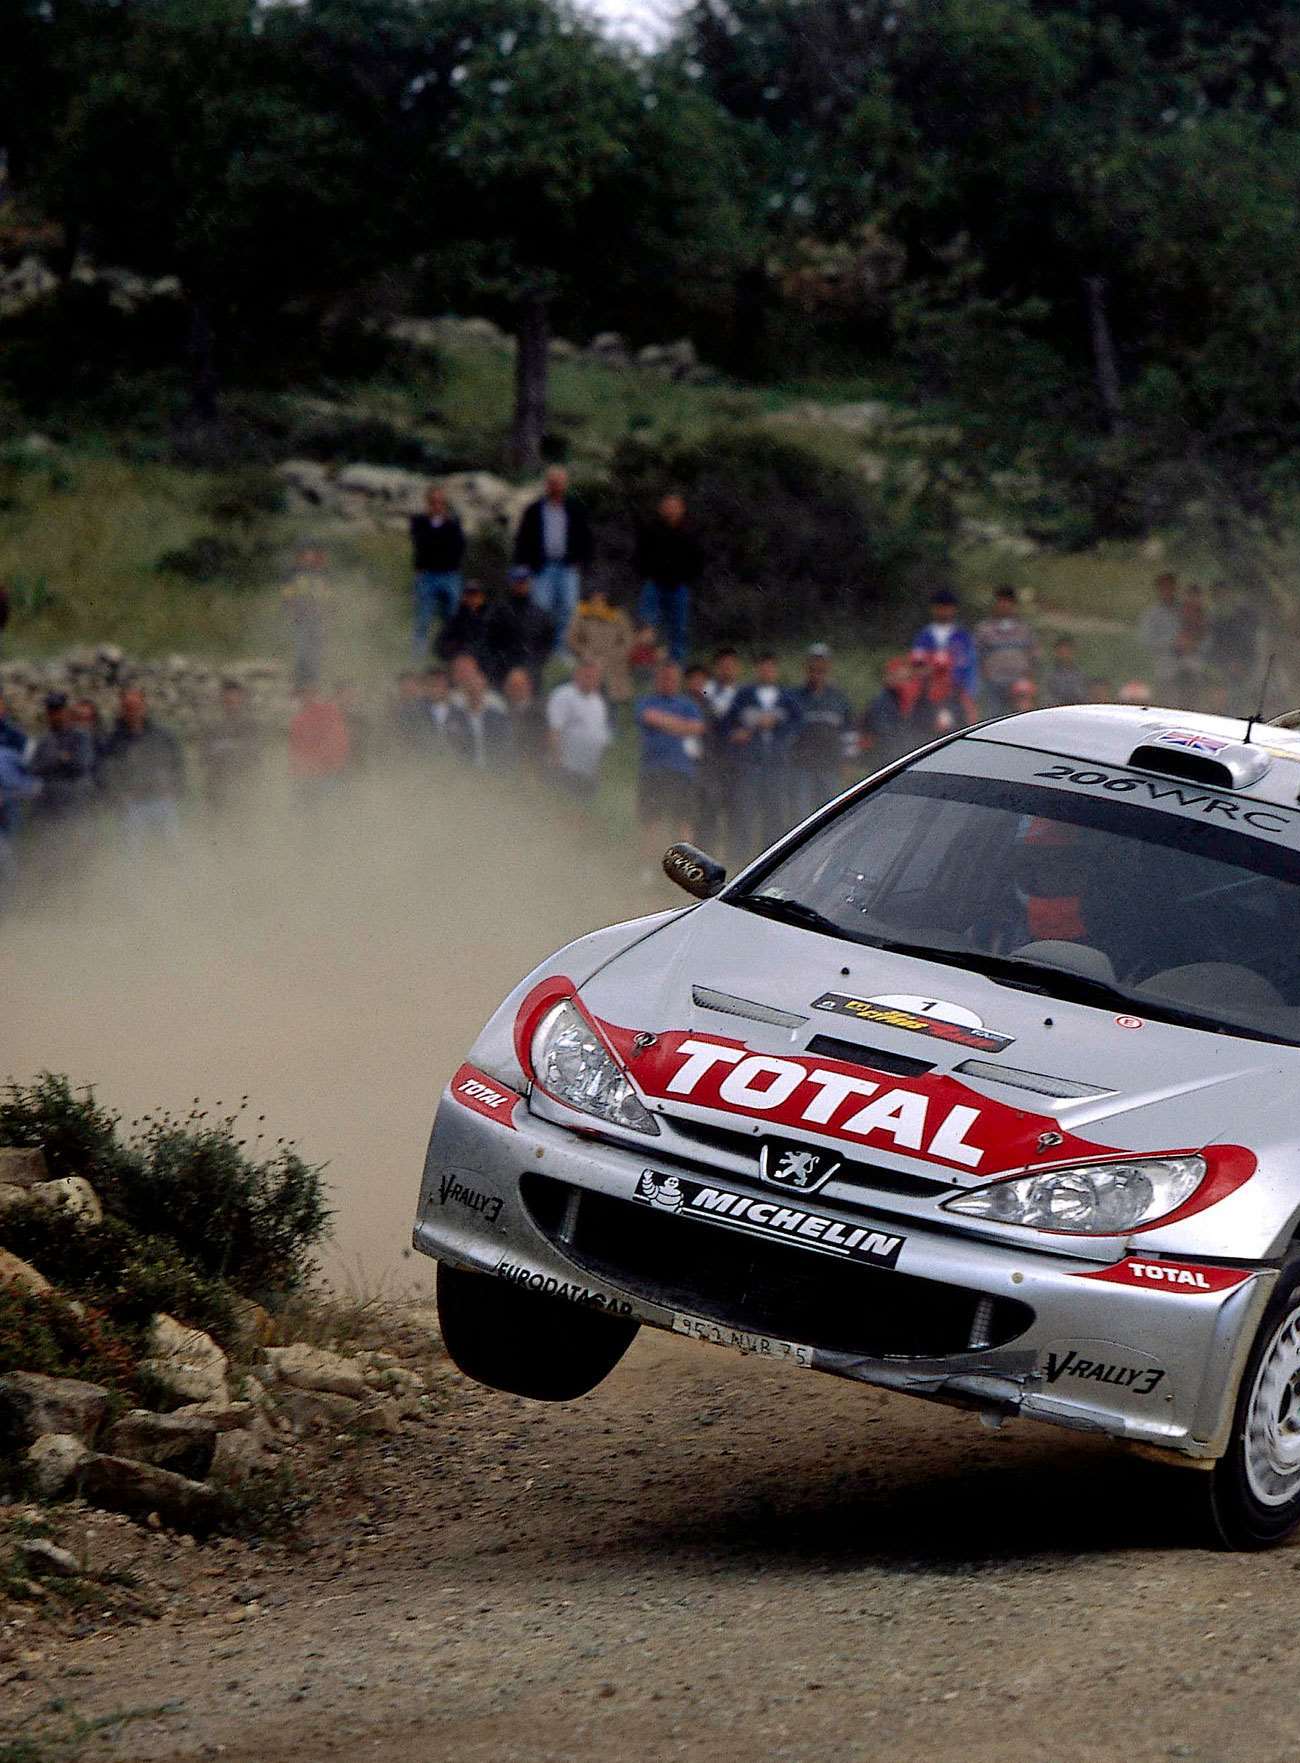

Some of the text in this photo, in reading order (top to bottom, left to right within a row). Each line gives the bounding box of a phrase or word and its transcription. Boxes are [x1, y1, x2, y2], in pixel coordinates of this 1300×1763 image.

[921, 1001, 938, 1011] 1
[457, 1079, 509, 1108] TOTAL
[666, 1040, 985, 1168] TOTAL
[692, 1188, 901, 1256] MICHELIN
[499, 1262, 634, 1315] EURODATACAR
[1128, 1263, 1210, 1289] TOTAL
